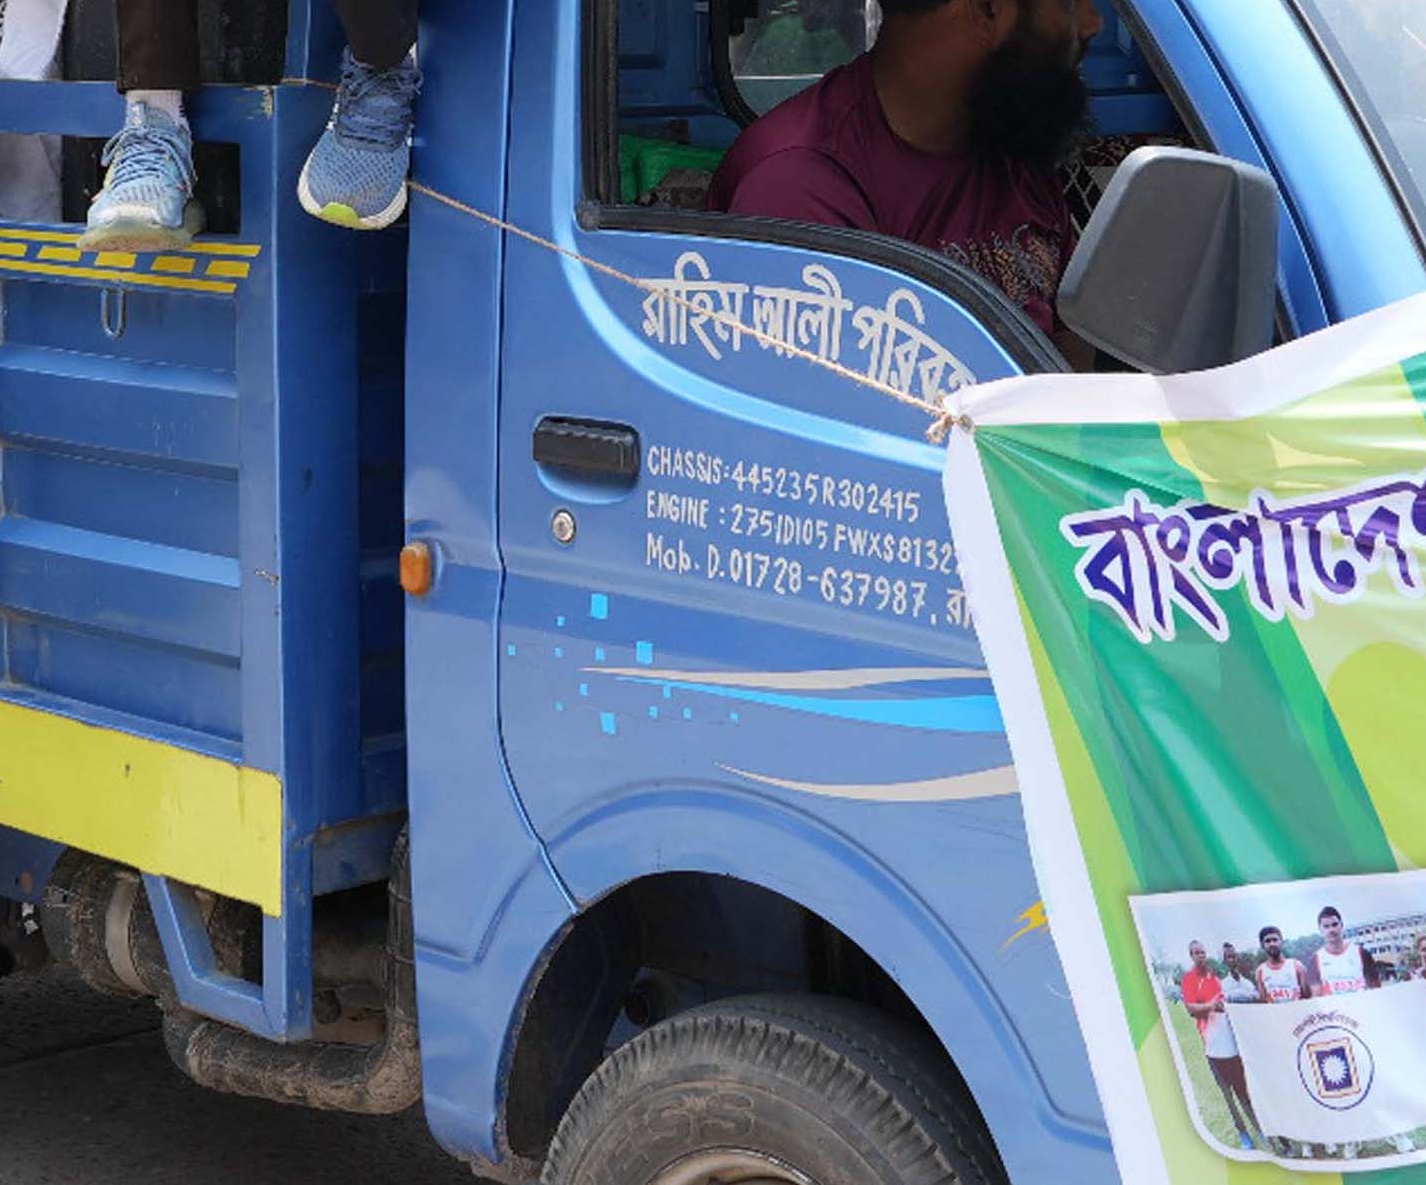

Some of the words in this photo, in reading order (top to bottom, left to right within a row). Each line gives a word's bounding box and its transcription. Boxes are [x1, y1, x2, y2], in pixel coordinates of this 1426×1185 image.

[638, 251, 750, 361] রাহিম
[754, 263, 853, 361] আলী
[647, 490, 710, 530] ENGINE
[646, 532, 700, 575] Mob.
